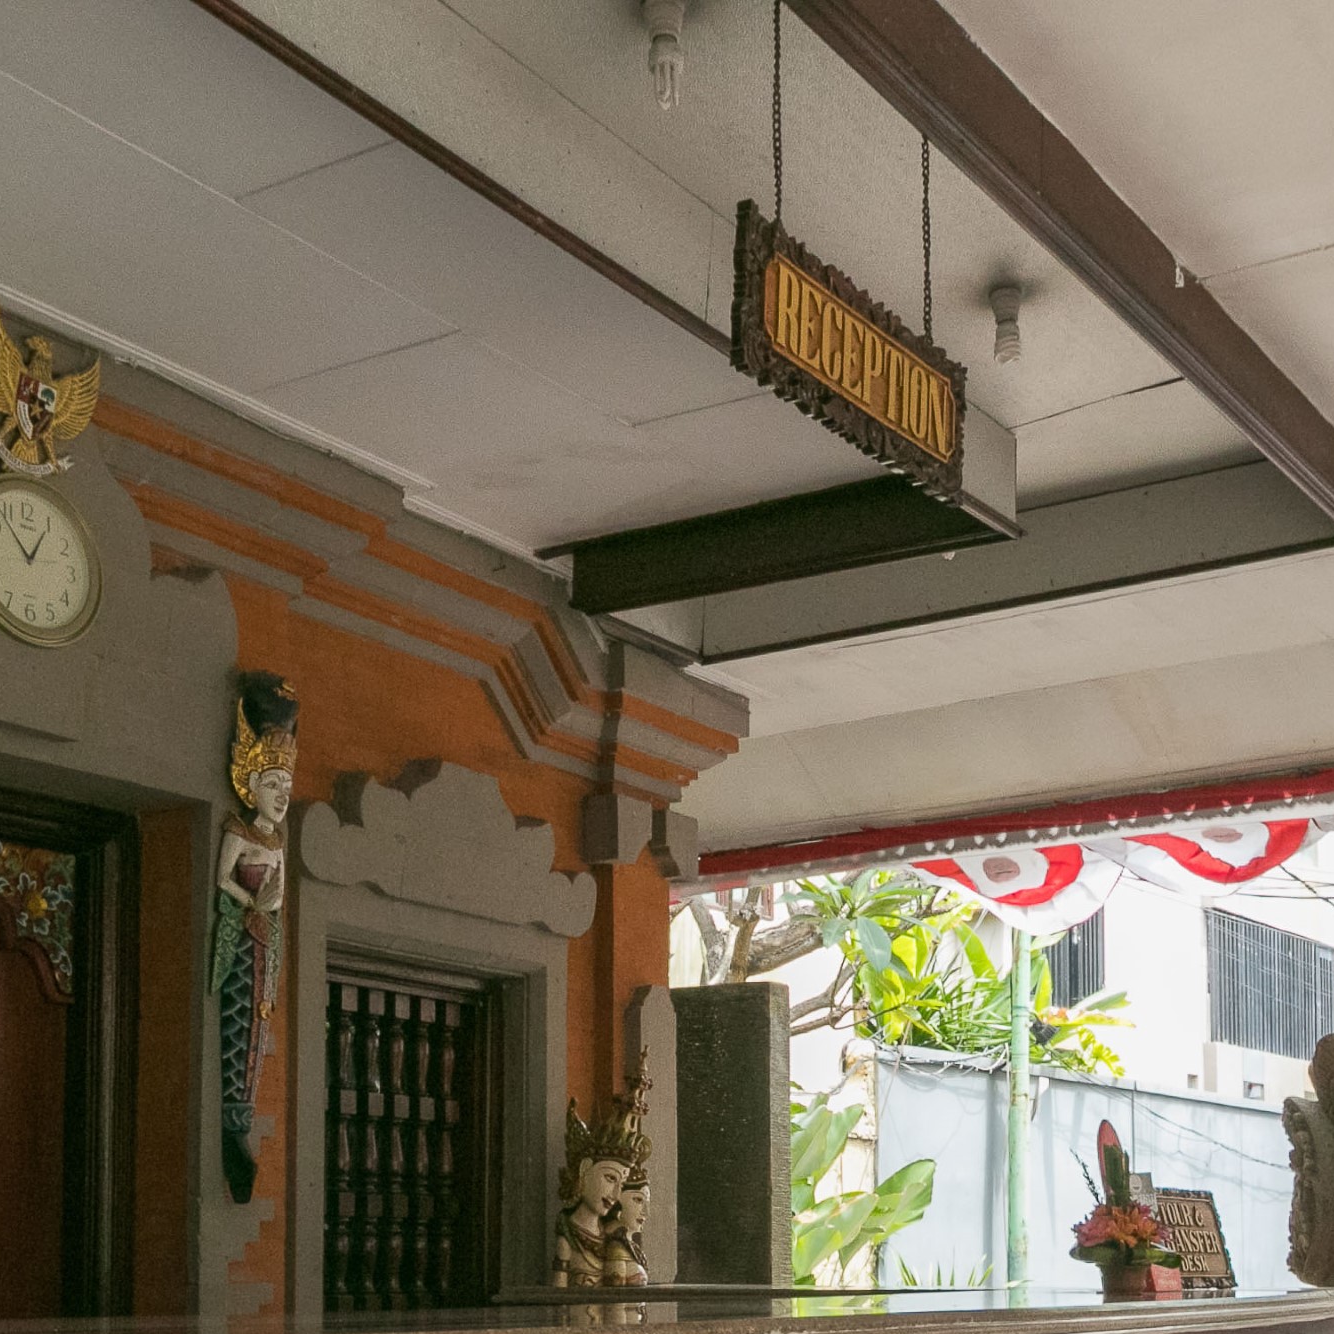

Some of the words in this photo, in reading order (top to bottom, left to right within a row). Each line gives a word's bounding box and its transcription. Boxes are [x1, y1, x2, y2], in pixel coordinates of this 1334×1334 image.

[776, 262, 948, 456] RECEPTION
[21, 502, 35, 522] 12
[59, 538, 70, 557] 2
[66, 566, 76, 584] 3
[4, 590, 14, 609] 7
[59, 589, 70, 607] 4
[24, 604, 37, 623] 6
[45, 603, 55, 622] 5
[1158, 1202, 1195, 1227] TOUR
[1181, 1255, 1211, 1273] DESK
